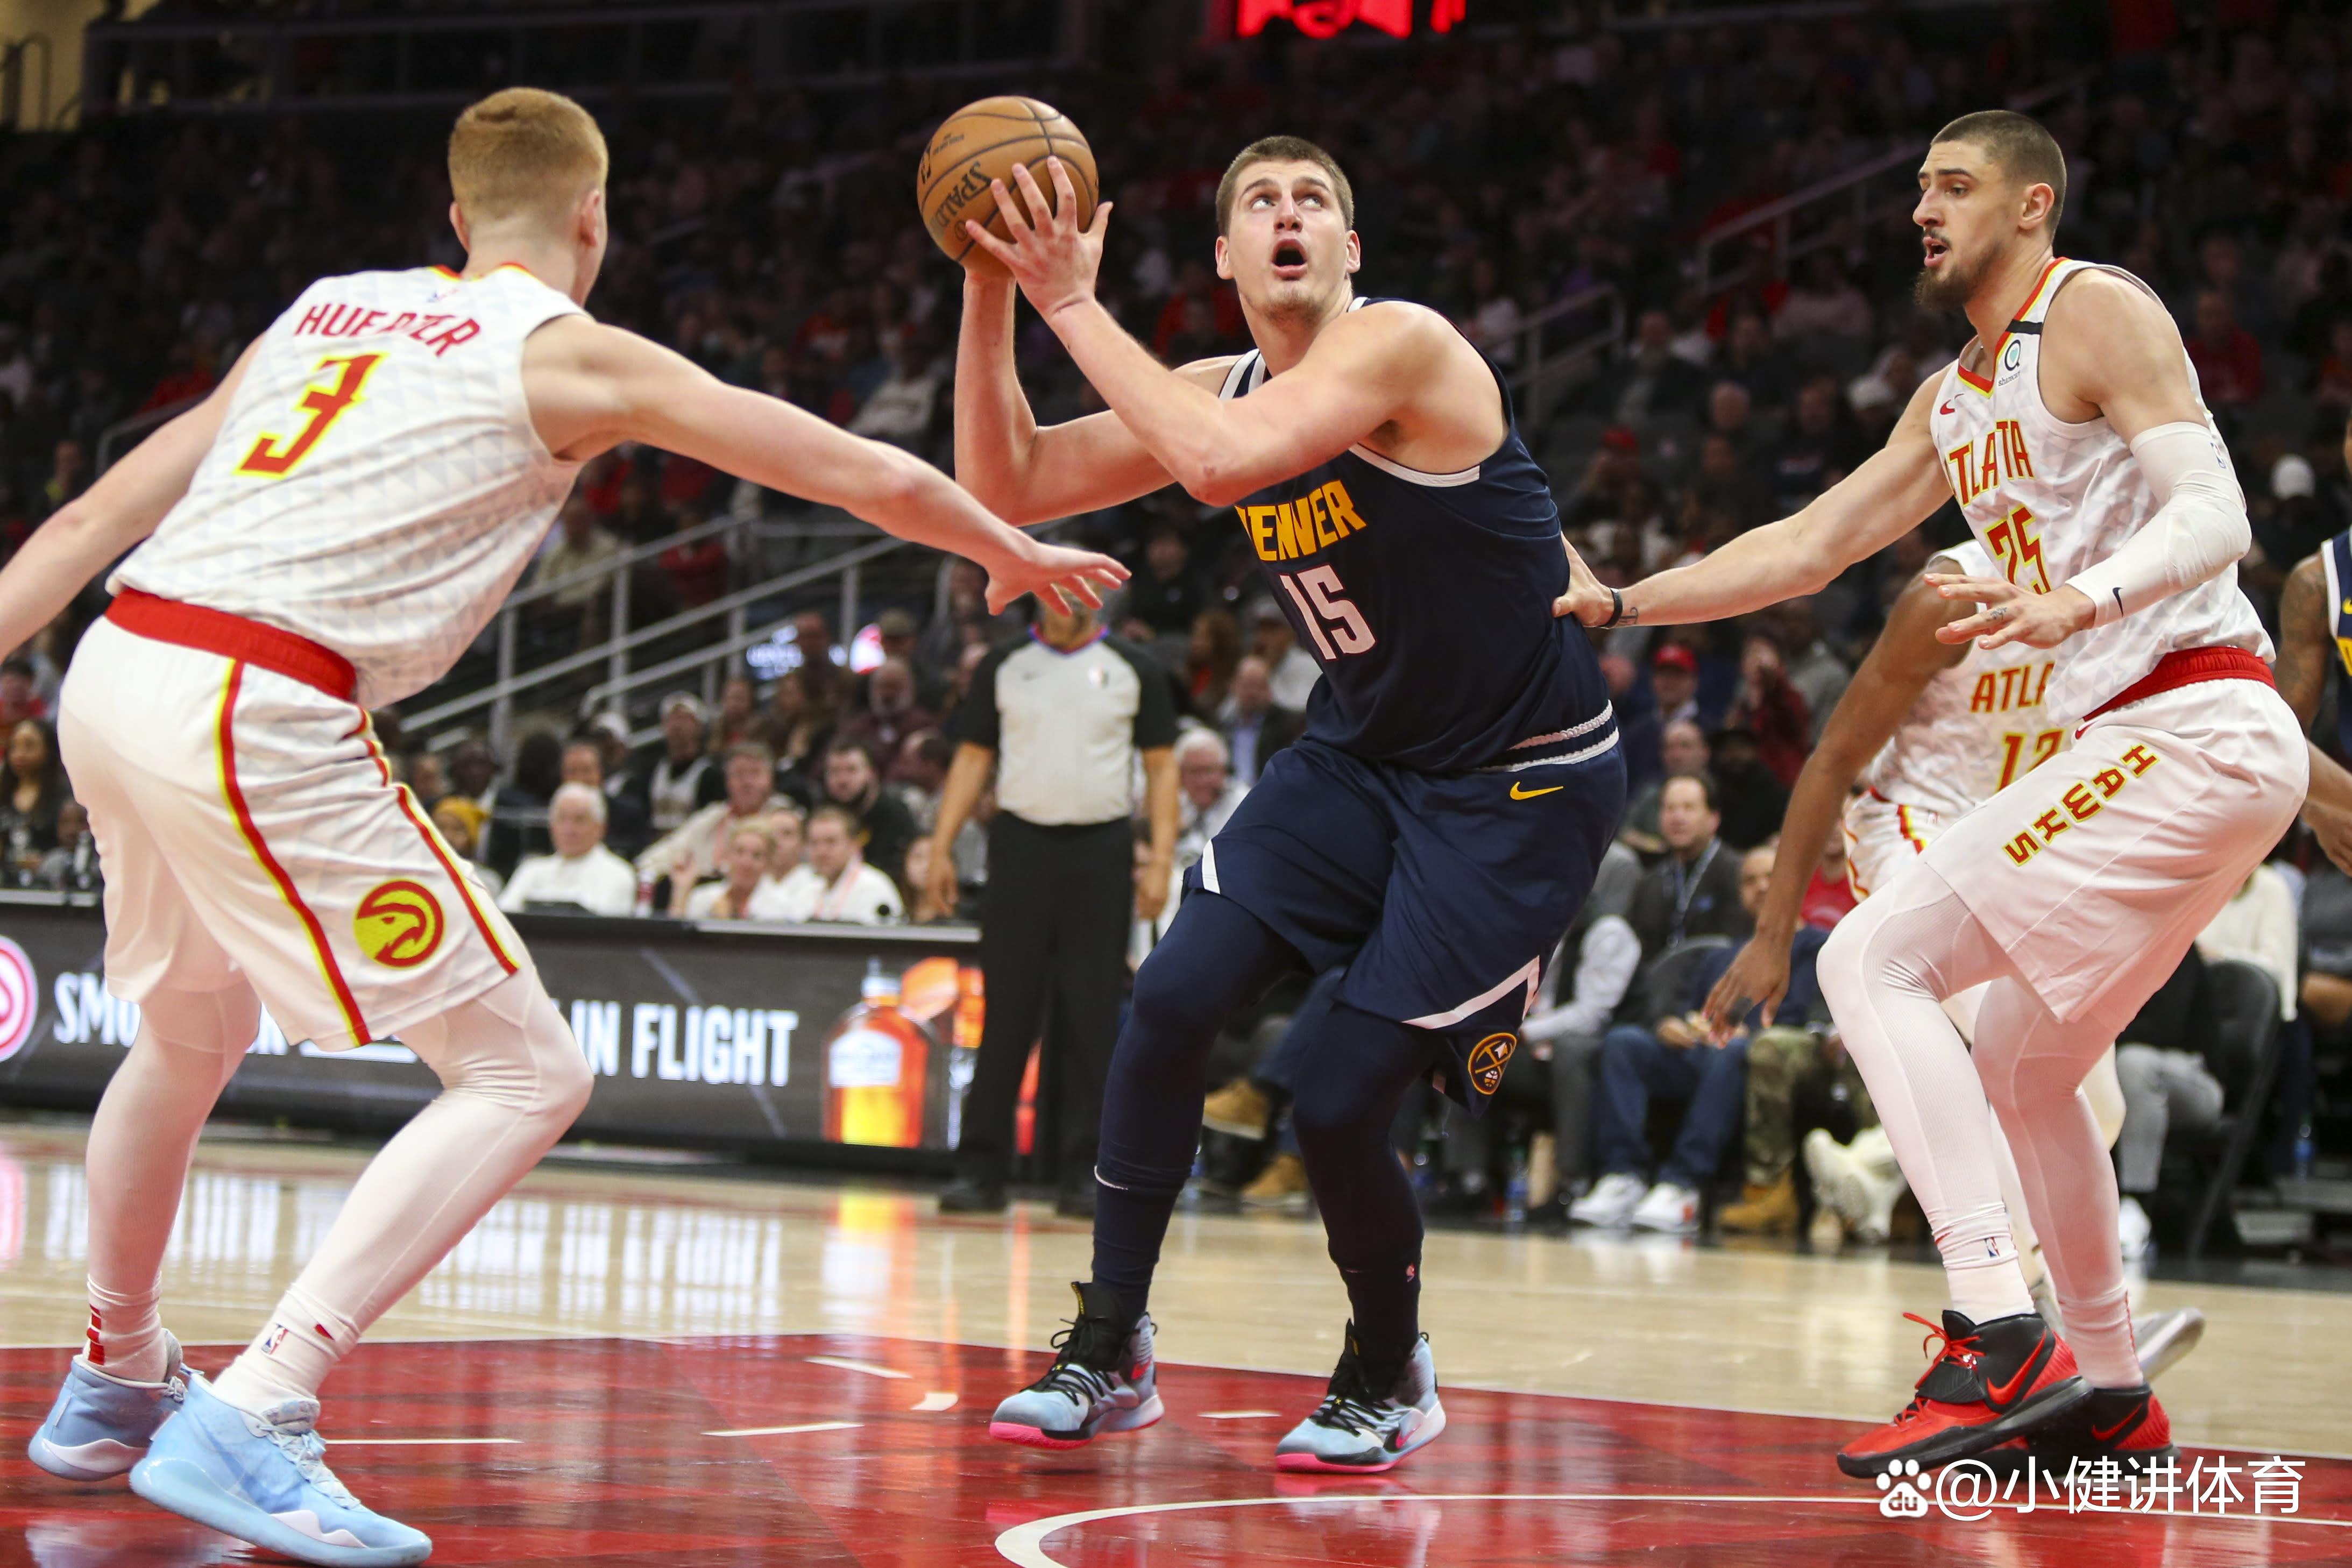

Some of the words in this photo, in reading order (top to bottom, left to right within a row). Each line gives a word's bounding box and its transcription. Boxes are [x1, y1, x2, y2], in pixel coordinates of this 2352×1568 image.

[932, 161, 993, 228] SPALD
[232, 351, 389, 480] 3
[1945, 418, 2036, 508] TLATA
[1234, 479, 1368, 562] ENVER
[1983, 503, 2063, 595] 25
[1279, 563, 1377, 661] 15
[1993, 728, 2066, 795] 12
[2002, 744, 2159, 867] HAWKS
[53, 972, 141, 1048] SMO
[571, 999, 621, 1076] IN
[631, 1002, 799, 1087] FLIGHT
